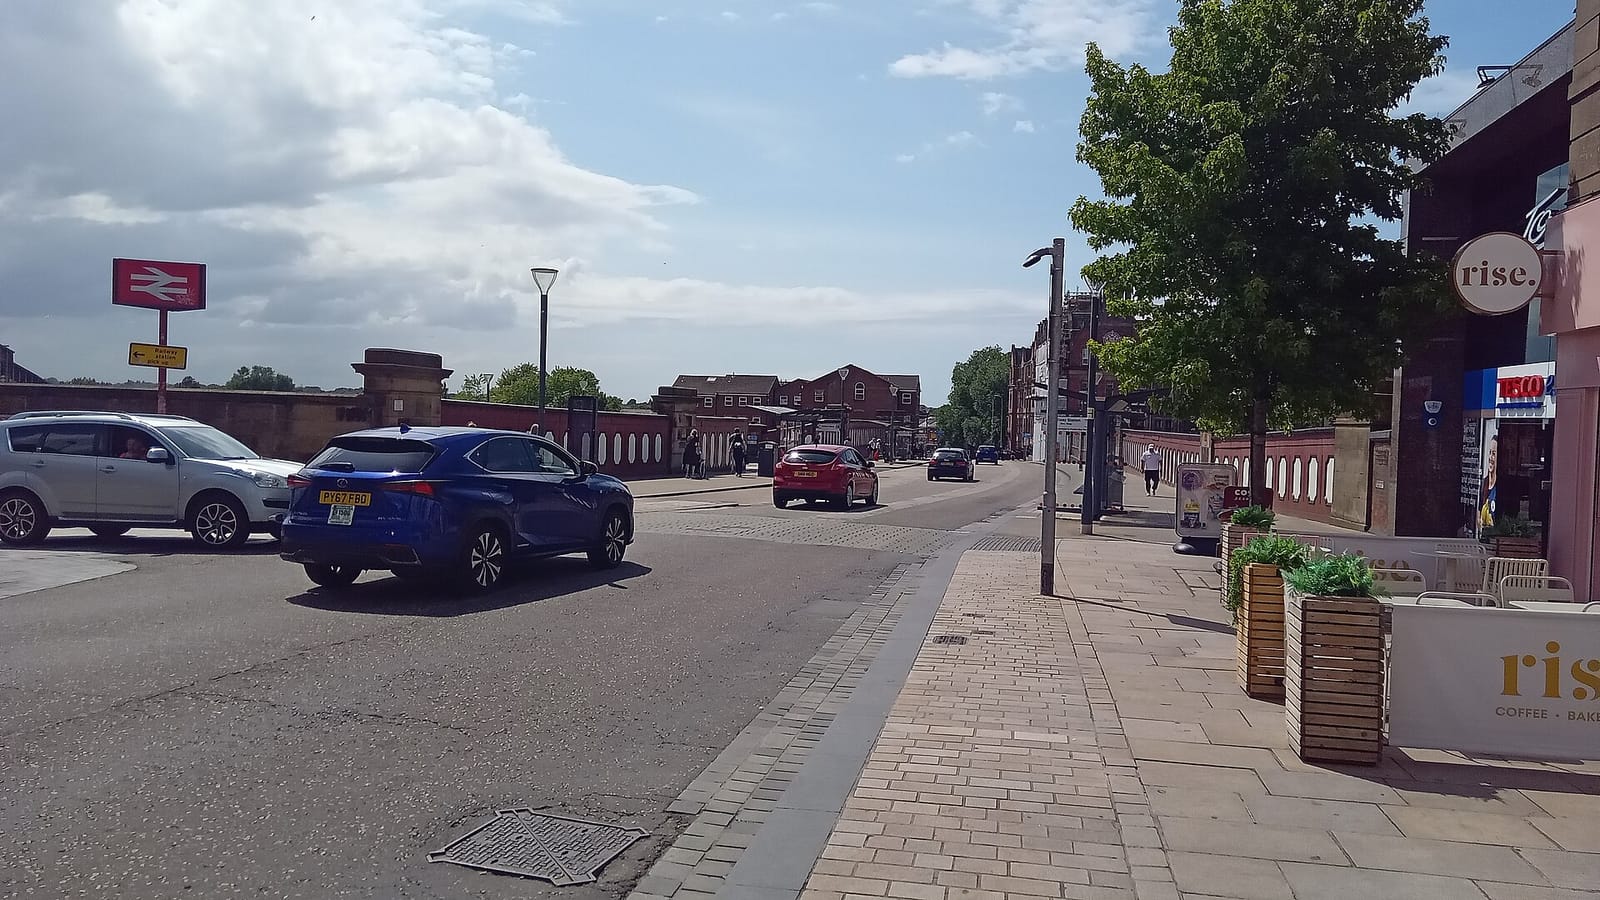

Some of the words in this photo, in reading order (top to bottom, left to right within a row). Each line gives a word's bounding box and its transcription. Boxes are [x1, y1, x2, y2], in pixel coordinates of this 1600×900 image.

[1462, 260, 1536, 287] rise.
[1498, 375, 1545, 398] TESCO
[323, 492, 347, 503] PY67
[1495, 706, 1549, 719] COFFEE
